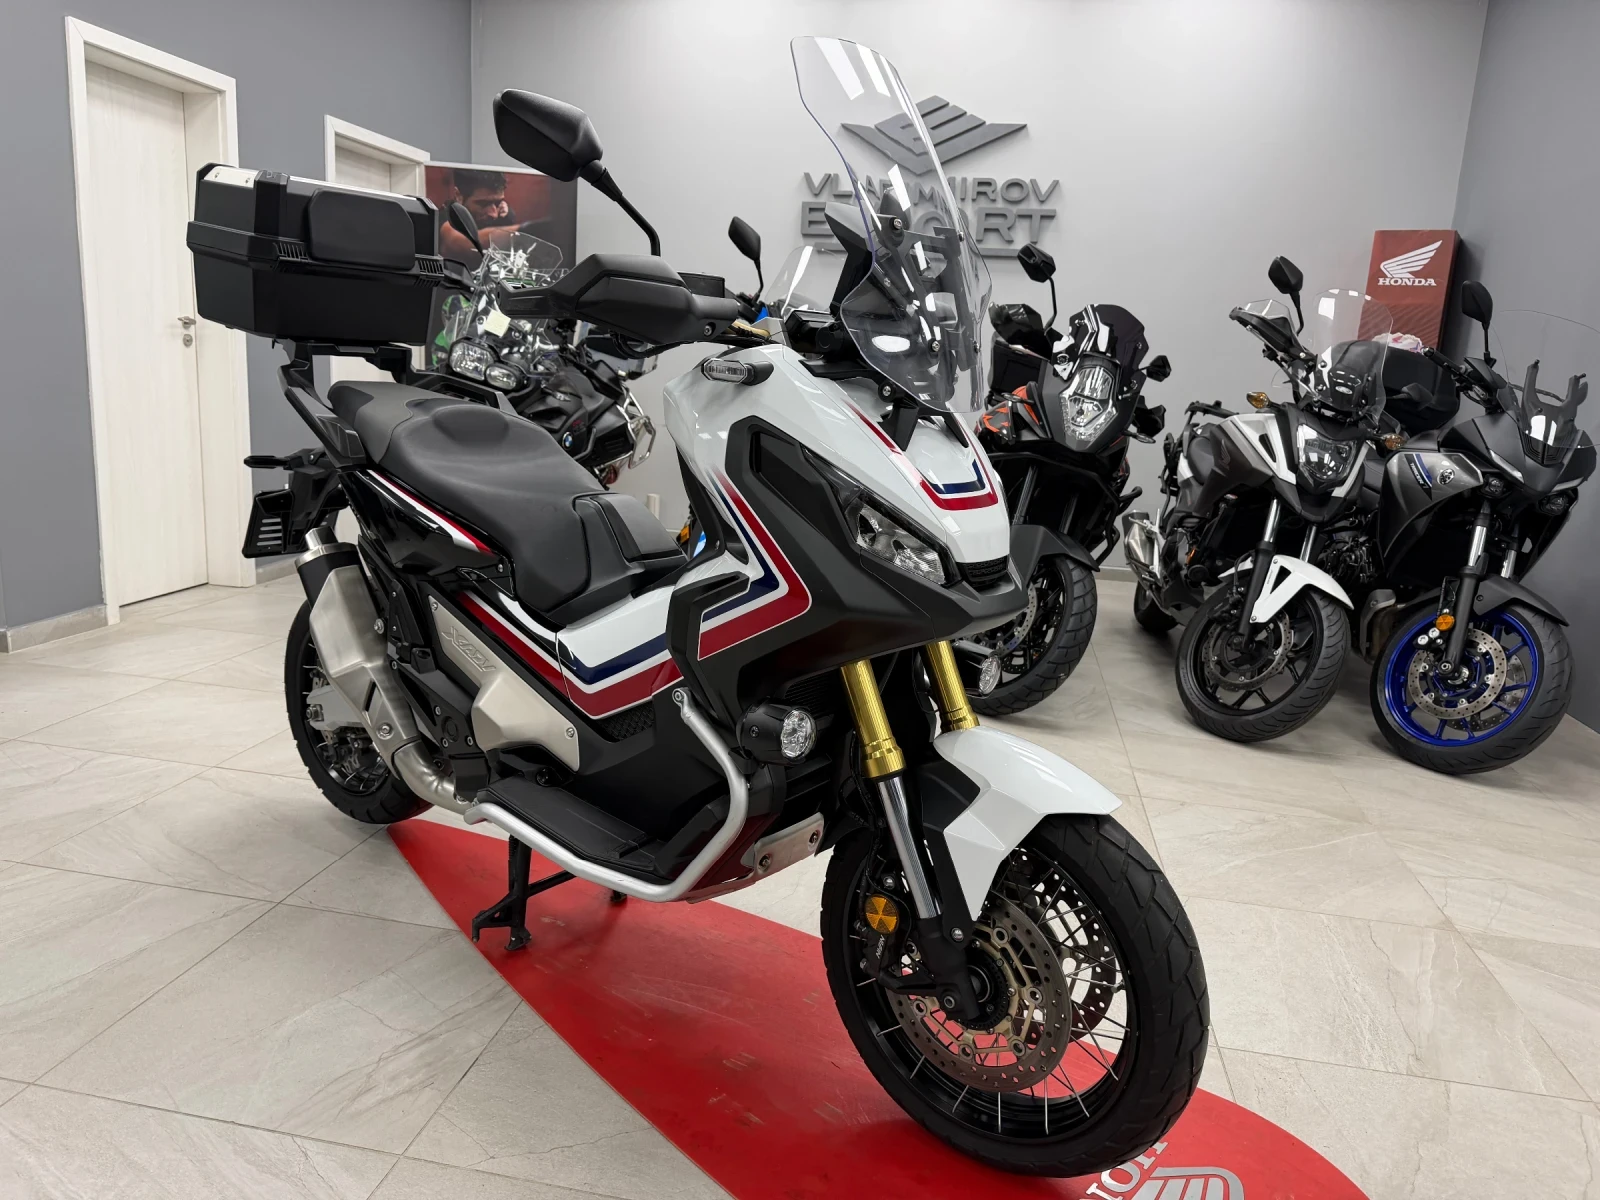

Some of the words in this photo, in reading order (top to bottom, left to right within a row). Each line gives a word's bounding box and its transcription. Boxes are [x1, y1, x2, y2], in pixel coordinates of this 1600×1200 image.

[803, 172, 1060, 205] VLAMIROV
[801, 202, 1057, 244] EORT
[1377, 277, 1437, 287] HONDA
